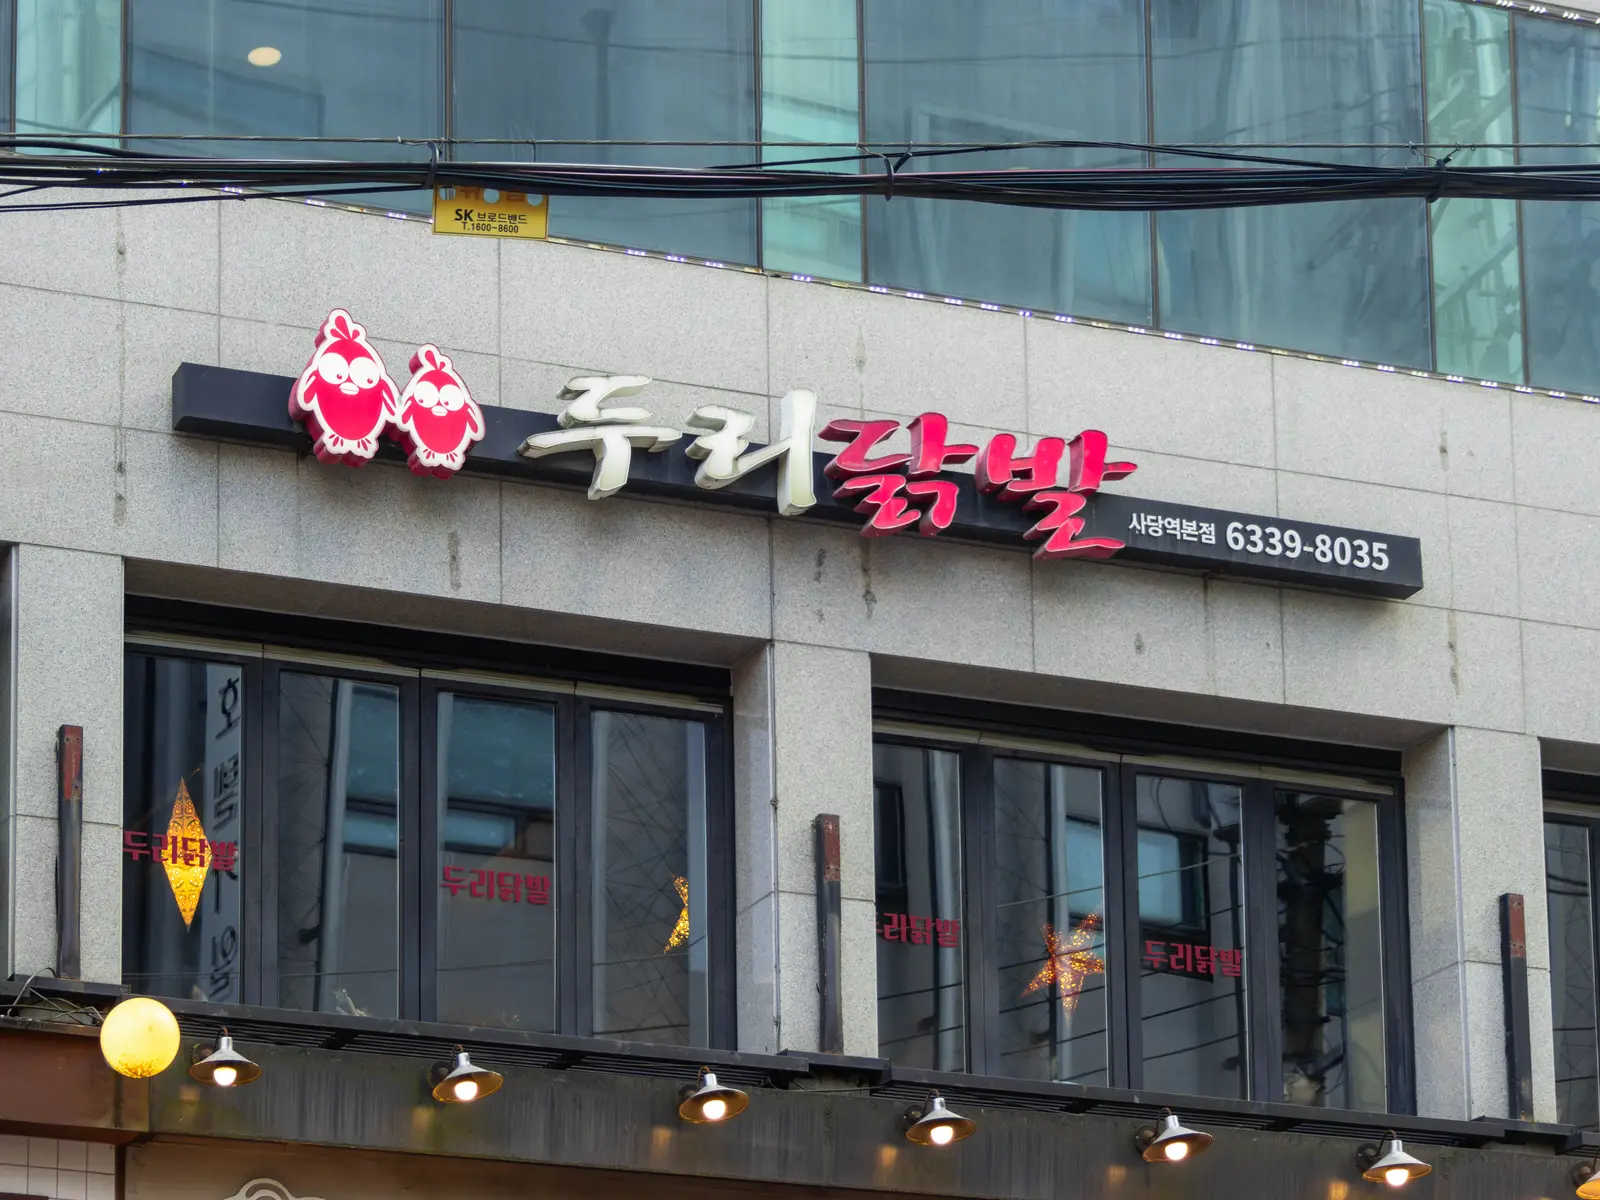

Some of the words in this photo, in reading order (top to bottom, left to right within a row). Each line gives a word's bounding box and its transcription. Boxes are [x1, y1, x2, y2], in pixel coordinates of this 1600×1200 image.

[454, 208, 474, 222] SK
[476, 211, 528, 225] 브로드밴드
[461, 221, 520, 233] T.1600-8600
[1128, 512, 1217, 545] 사당역본점
[1225, 521, 1390, 572] 6339-8035
[122, 829, 239, 872] 두리닭발
[440, 865, 553, 905] 두리닭발
[876, 912, 961, 948] 리닭발
[1143, 939, 1244, 977] 두리닭발
